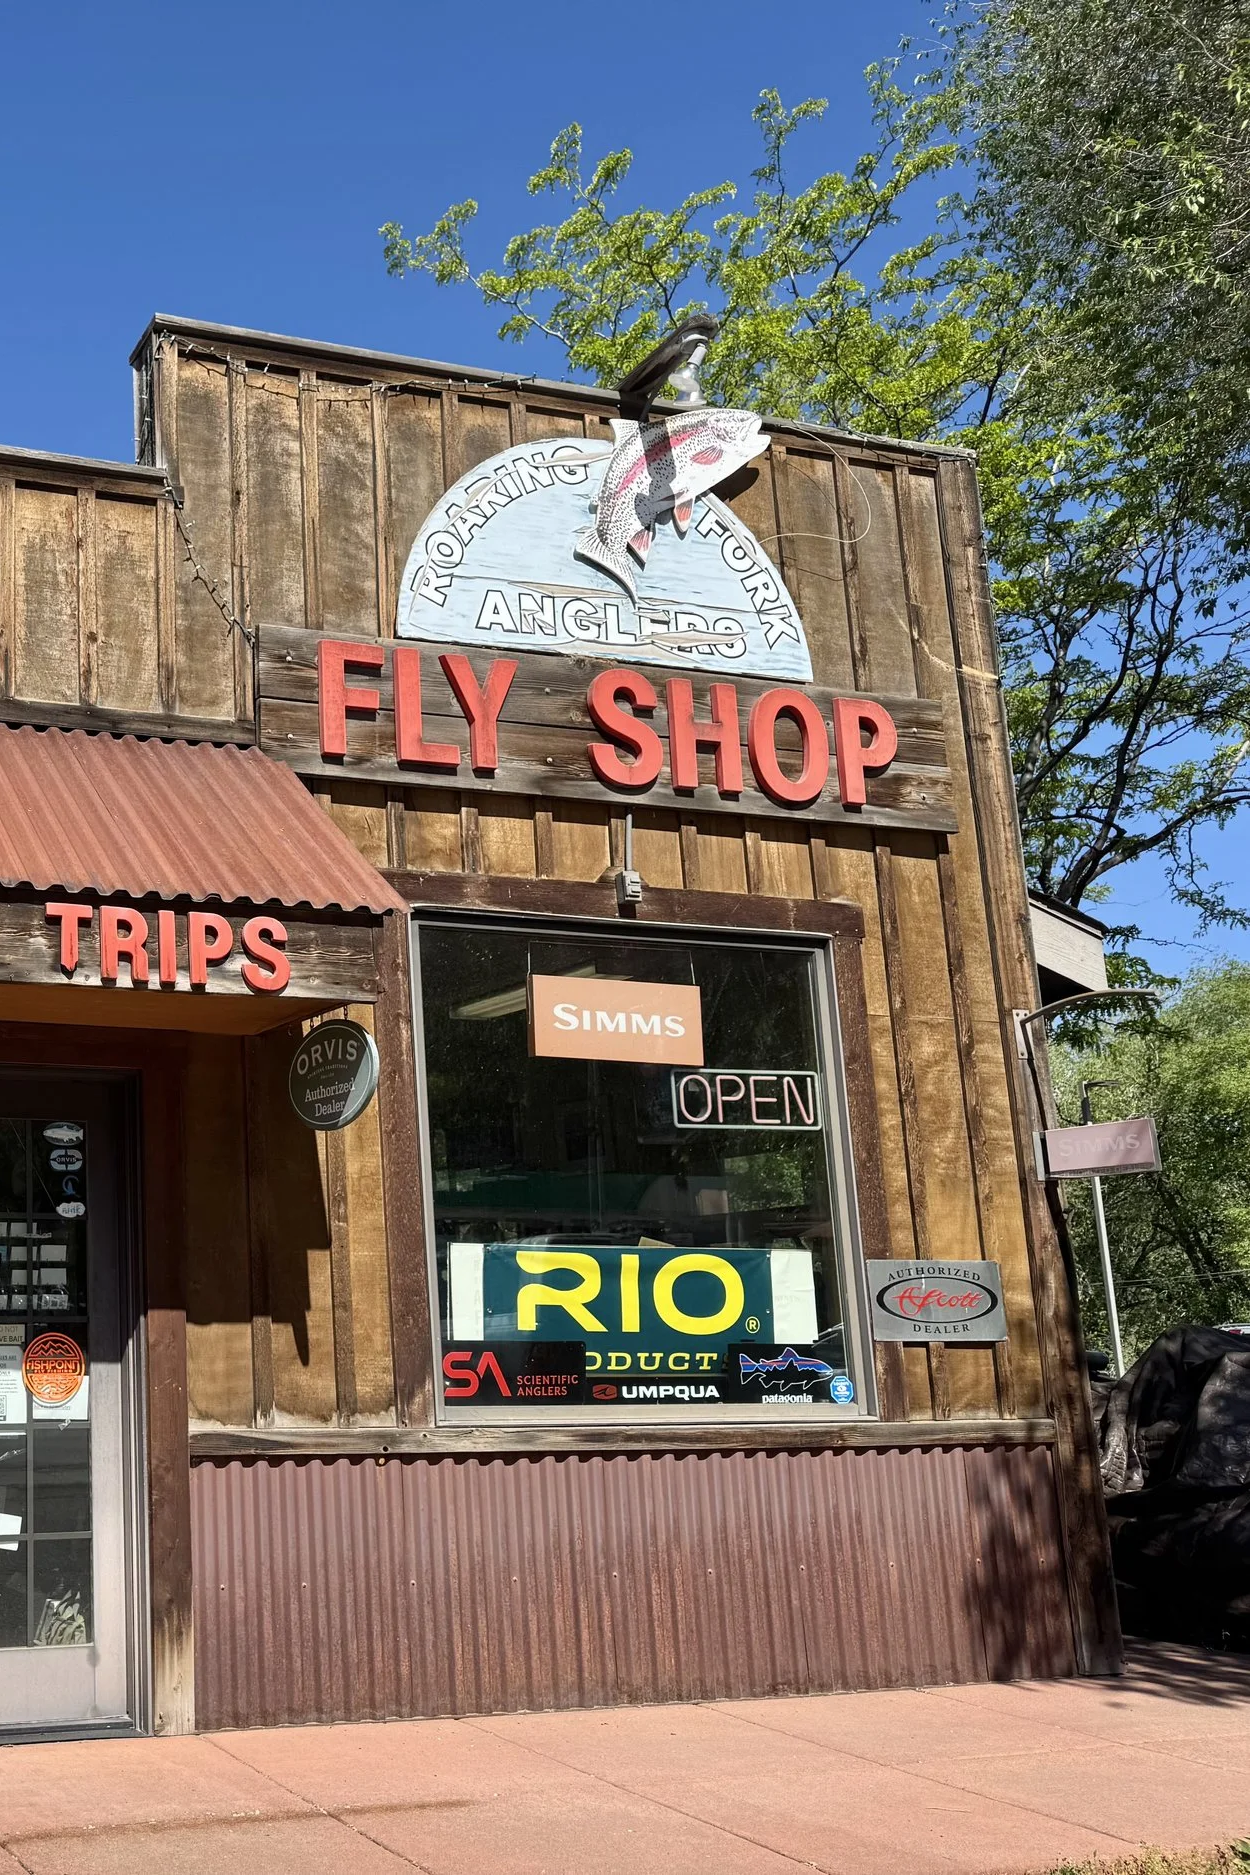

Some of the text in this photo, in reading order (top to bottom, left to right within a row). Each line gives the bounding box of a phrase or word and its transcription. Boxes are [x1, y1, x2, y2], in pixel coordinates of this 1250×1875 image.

[412, 445, 800, 652] ROARING FORK
[476, 590, 747, 659] ANGLERS
[318, 639, 898, 806] FLY SHOP
[45, 902, 291, 992] TRIPS
[553, 1002, 685, 1037] SIMMS
[297, 1039, 358, 1075] ORVIS
[305, 1078, 355, 1102] Authorized
[680, 1075, 814, 1125] OPEN
[315, 1100, 345, 1116] Dealer
[888, 1267, 980, 1281] AUTHORIZED
[516, 1250, 744, 1335] RIO
[914, 1323, 970, 1333] DEALER
[586, 1352, 728, 1371] ODUCT
[517, 1375, 579, 1385] SCIENTIFIC
[517, 1386, 568, 1396] ANGLERS
[622, 1385, 720, 1400] UMPQUA
[762, 1393, 813, 1404] patagonia
